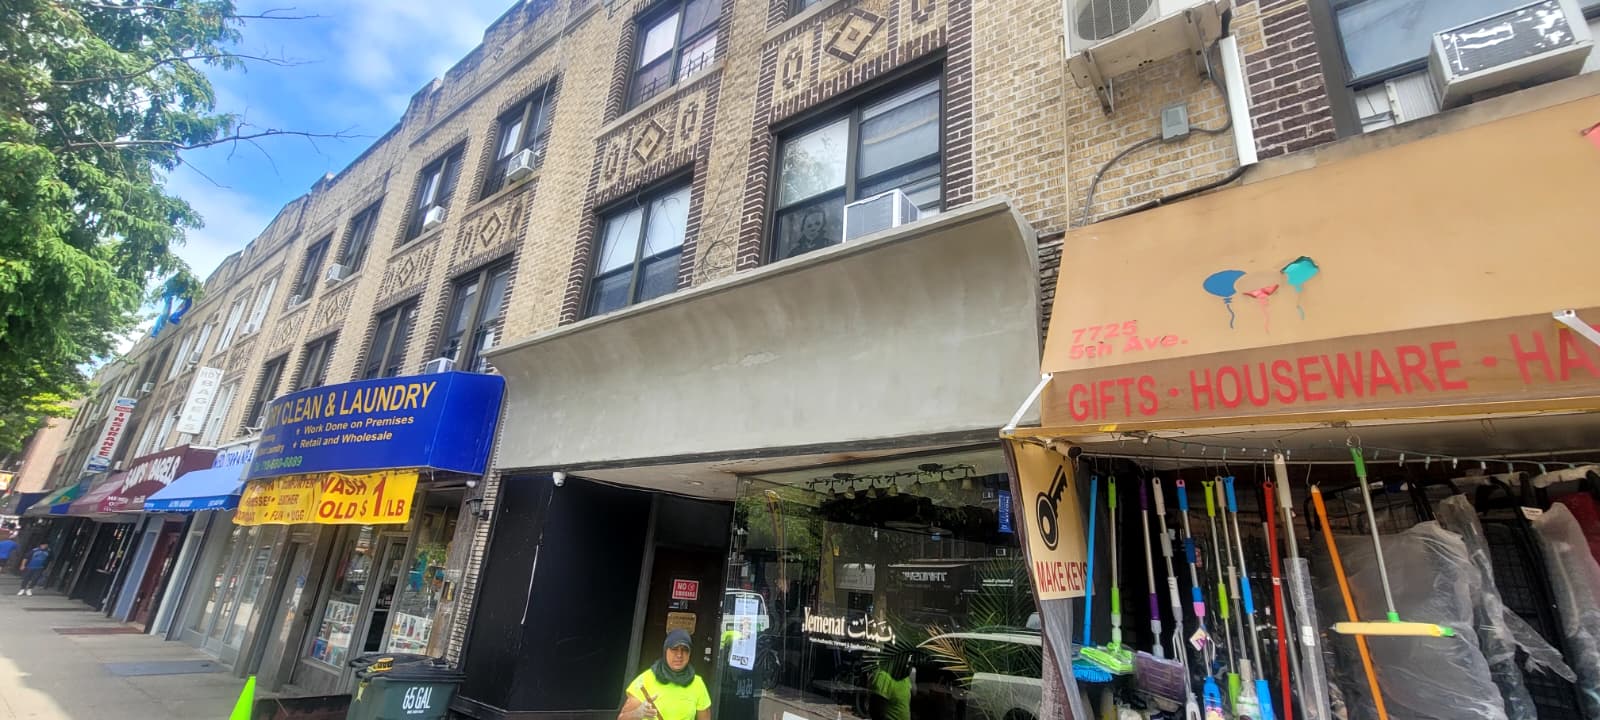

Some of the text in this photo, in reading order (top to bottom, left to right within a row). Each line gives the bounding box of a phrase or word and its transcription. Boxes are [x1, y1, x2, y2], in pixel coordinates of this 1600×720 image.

[1071, 320, 1137, 344] 7725
[1068, 335, 1189, 360] 5th Ave.
[1068, 374, 1160, 423] GIFTS
[1188, 340, 1470, 413] HOUSEWARE
[281, 393, 323, 425] CLEAN
[324, 391, 336, 417] &
[339, 381, 437, 416] LAUNDRY
[98, 412, 125, 457] INSURANCE
[304, 415, 415, 435] Work Done on Premises
[300, 431, 393, 449] Retail and Wholesale
[318, 499, 358, 519] OLD
[372, 475, 387, 517] 1
[677, 582, 687, 591] NO
[1036, 561, 1066, 593] MAKE
[803, 606, 846, 637] Yemenat
[402, 686, 433, 710] 65 GAL
